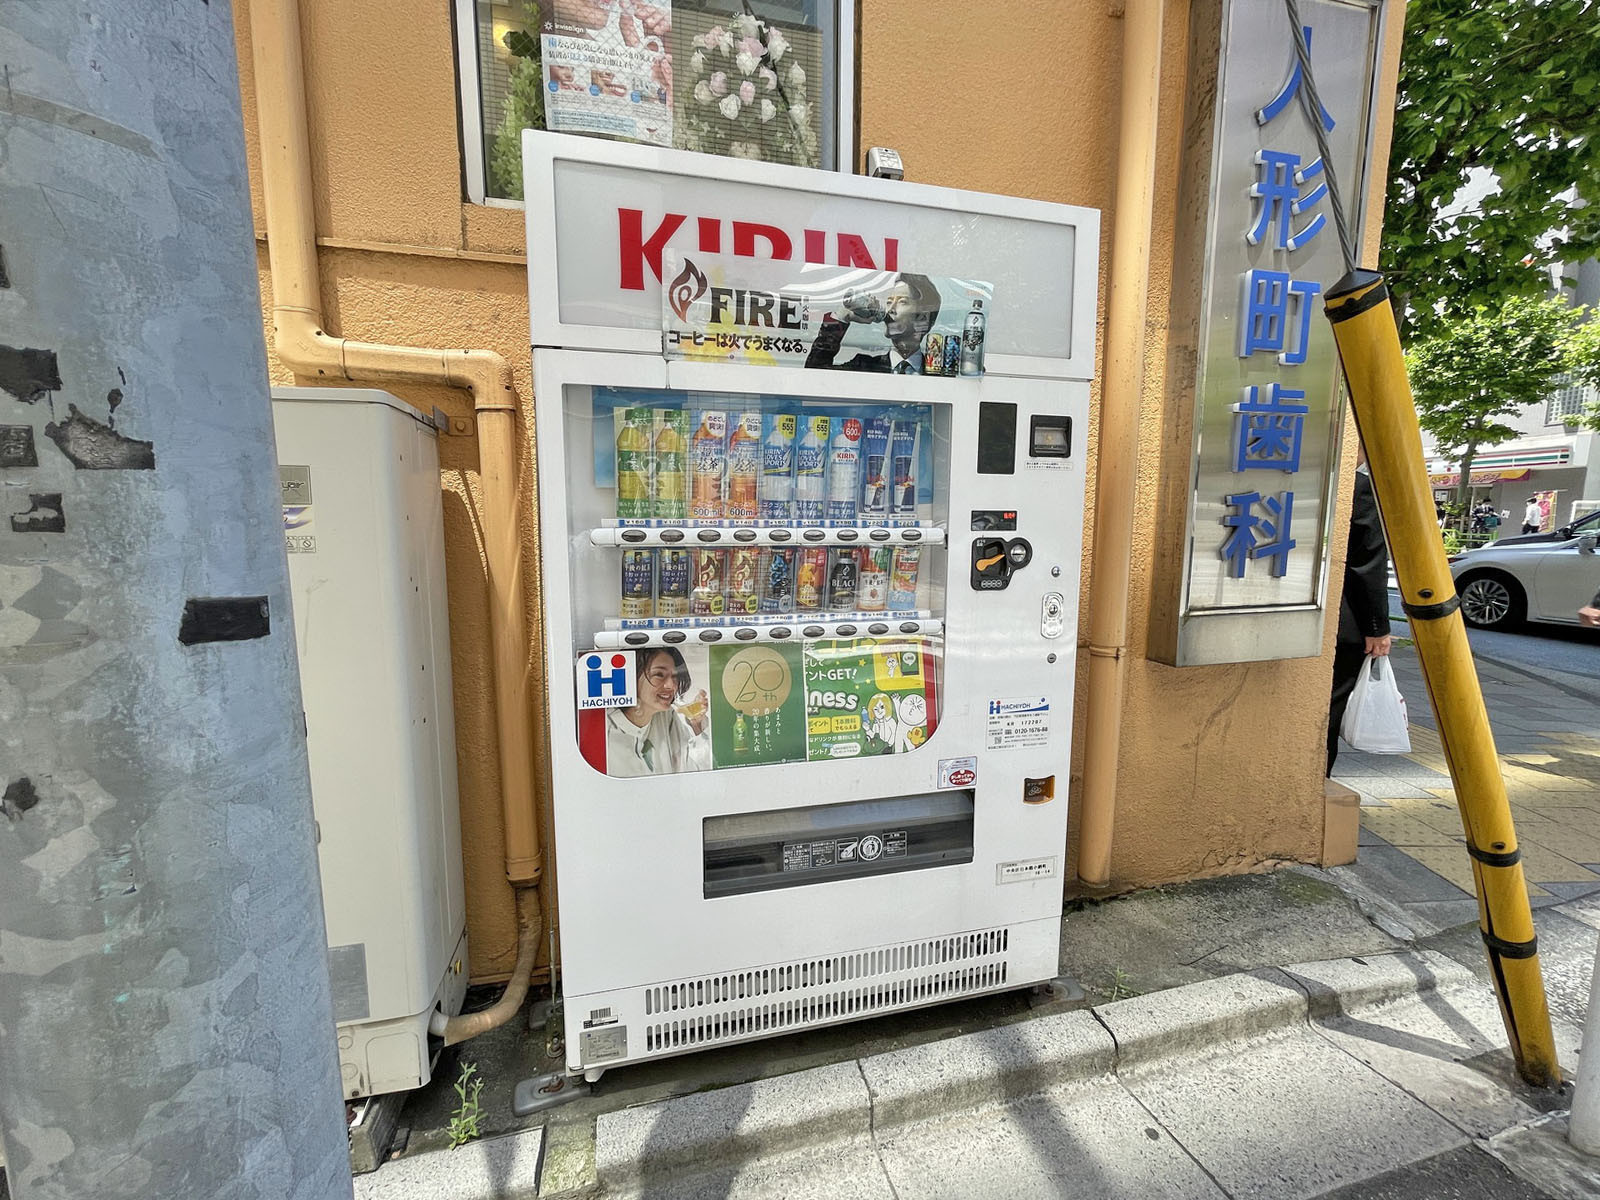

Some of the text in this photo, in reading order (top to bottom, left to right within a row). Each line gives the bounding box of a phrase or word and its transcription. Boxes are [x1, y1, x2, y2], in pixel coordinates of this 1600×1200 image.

[710, 287, 802, 330] FIRE
[1221, 25, 1336, 580] 人形町歯科
[668, 329, 808, 354] コーヒーは火でうまくなる。
[782, 423, 794, 431] 555
[816, 424, 828, 432] 555
[805, 668, 858, 681] ントGET!
[582, 697, 633, 707] HACHIYOH
[806, 689, 858, 711] ness
